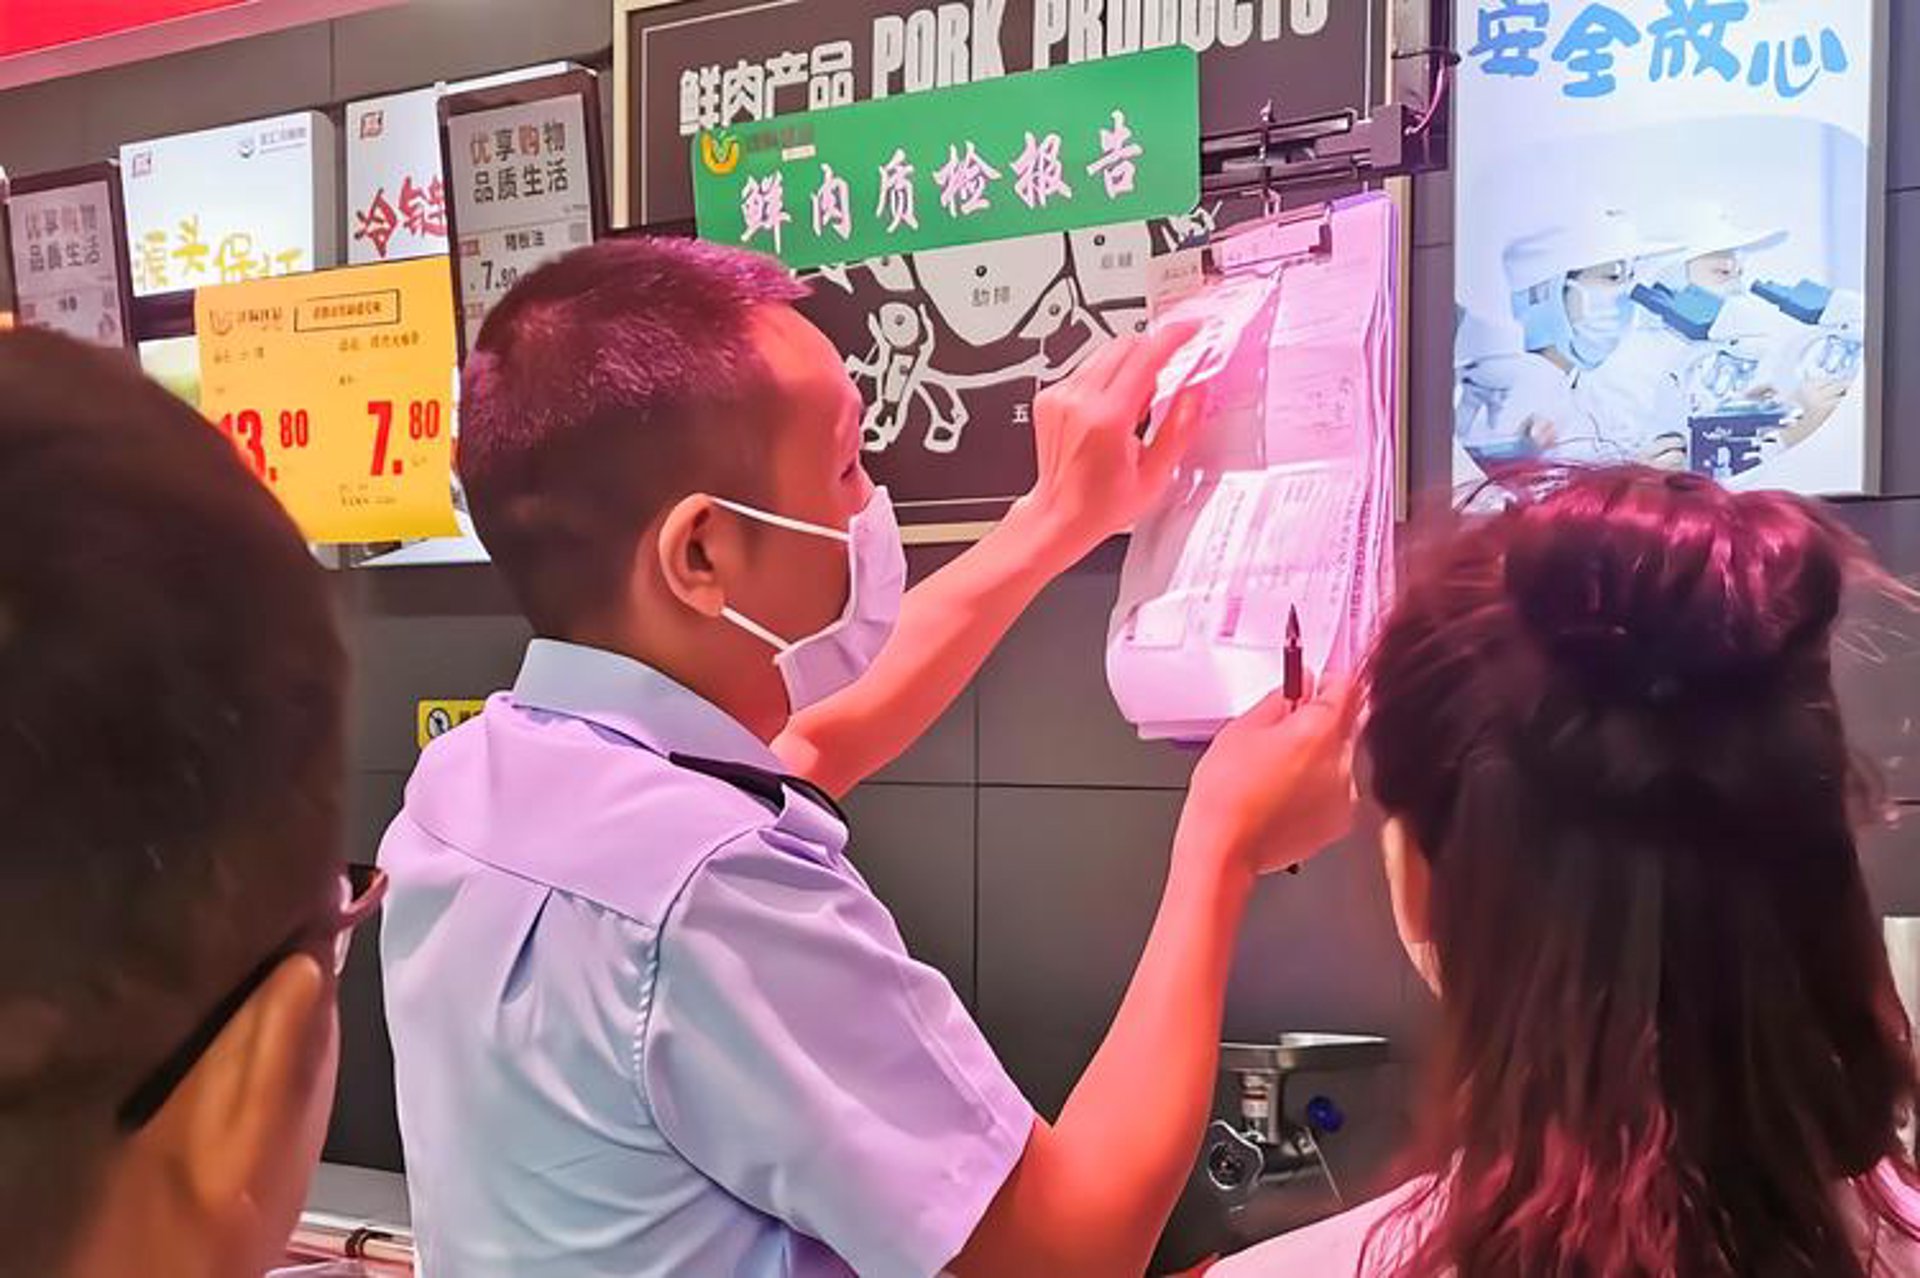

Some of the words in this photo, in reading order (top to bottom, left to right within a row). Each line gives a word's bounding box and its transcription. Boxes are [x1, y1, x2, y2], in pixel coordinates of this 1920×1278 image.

[679, 40, 855, 135] 鲜肉产品
[869, 0, 1007, 99] PORK
[1468, 0, 1849, 98] 安全放心
[474, 159, 569, 205] 品质生活
[740, 109, 1144, 255] 鲜肉质检报告
[367, 399, 441, 477] 7.80
